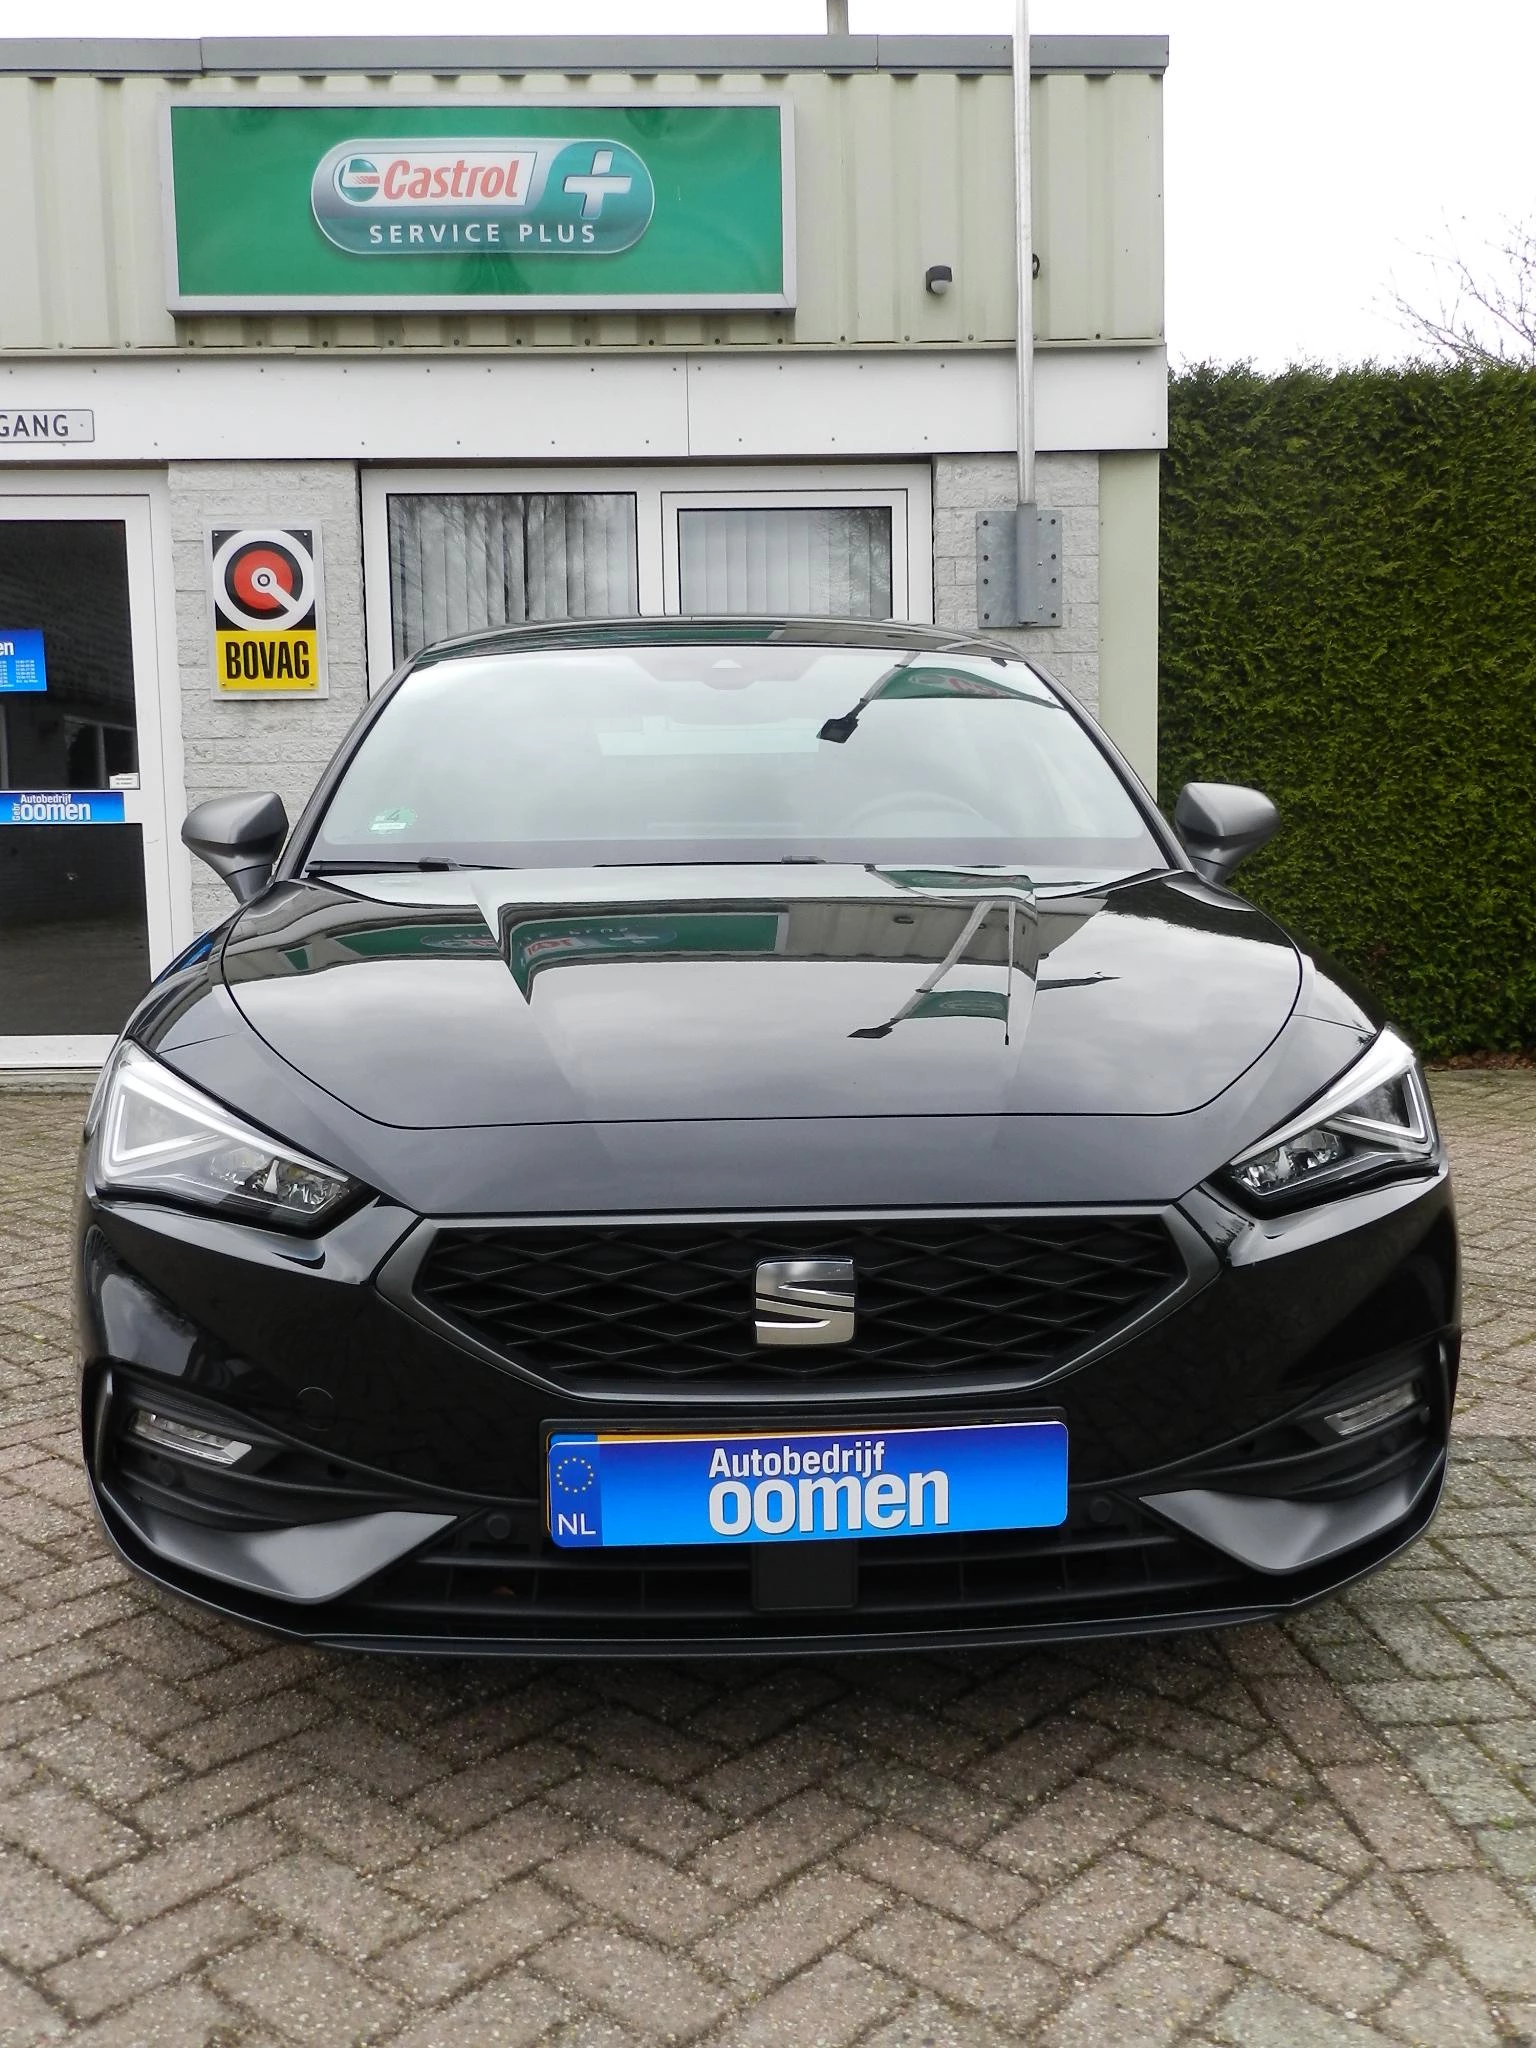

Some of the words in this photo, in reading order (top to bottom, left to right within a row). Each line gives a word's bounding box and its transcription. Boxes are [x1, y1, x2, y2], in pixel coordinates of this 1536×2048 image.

[384, 159, 520, 200] Castrol
[369, 223, 500, 244] SERVICE
[519, 223, 595, 243] PLUS
[225, 640, 310, 680] BOVAG
[21, 793, 72, 805] Autobedrijf
[21, 803, 91, 821] oomen
[708, 1440, 886, 1479] Autobedrijf
[708, 1468, 949, 1536] oomen
[557, 1513, 596, 1536] NL
